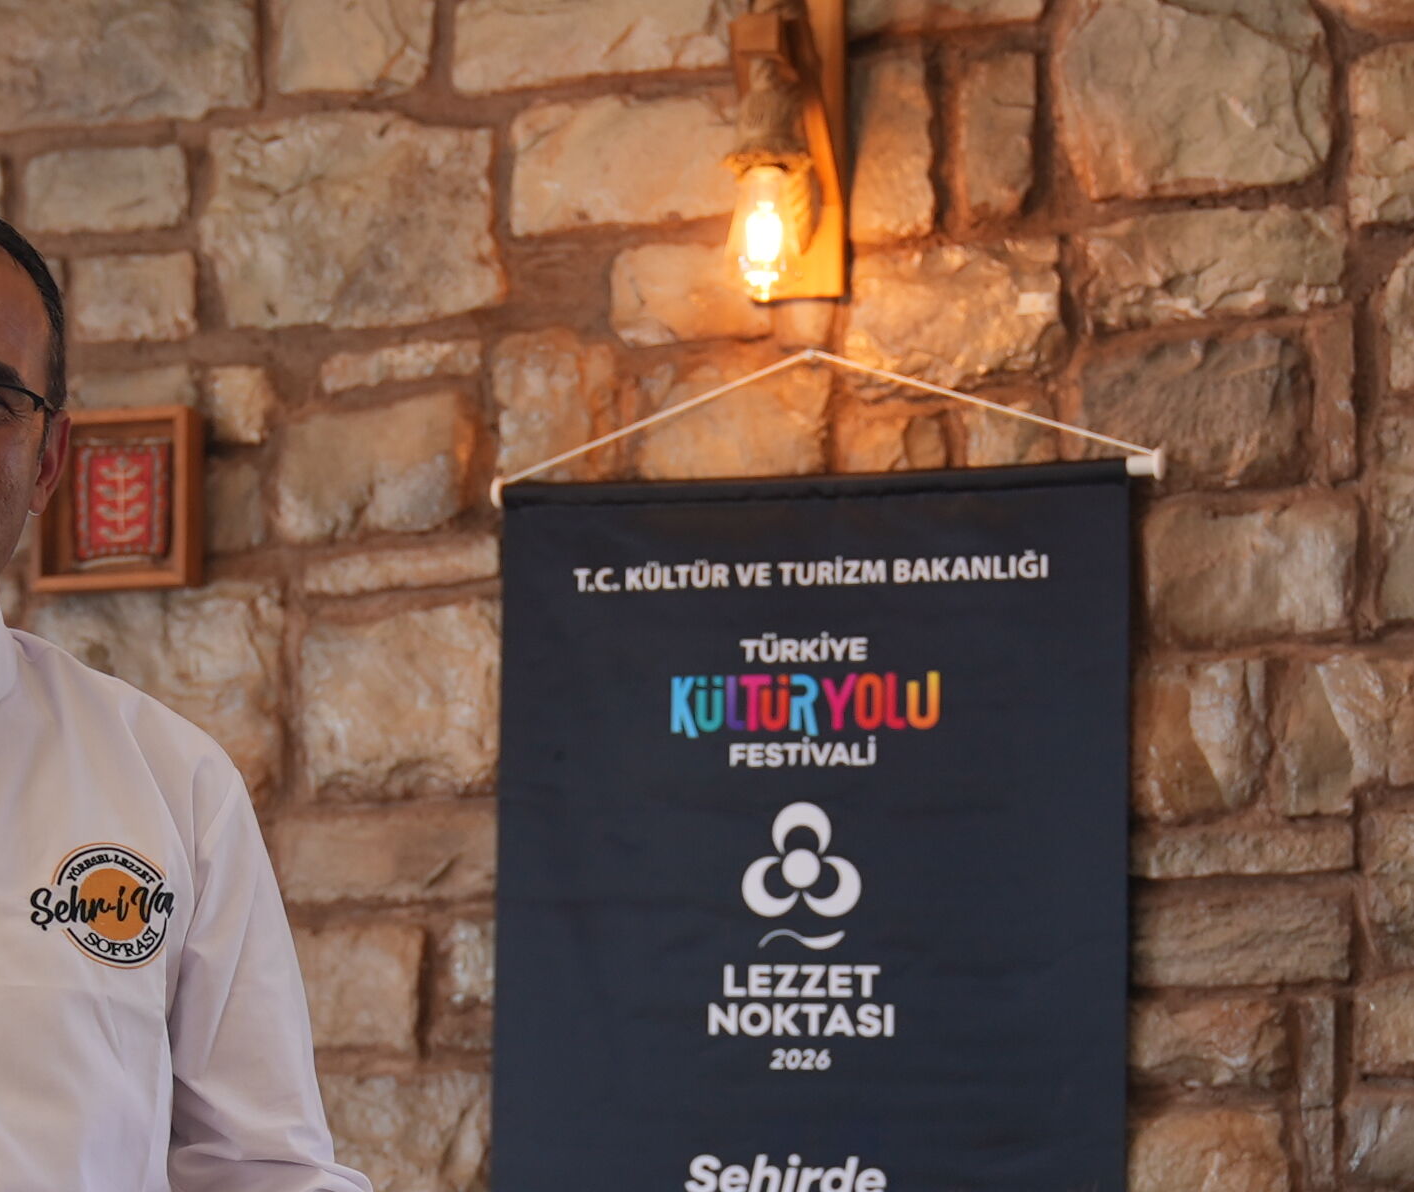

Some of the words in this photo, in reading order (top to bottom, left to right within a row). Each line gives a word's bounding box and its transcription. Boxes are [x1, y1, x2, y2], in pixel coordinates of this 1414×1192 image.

[573, 567, 621, 593] T.C.
[624, 559, 730, 591] KÜLTÜR
[734, 562, 772, 588] VE
[777, 555, 887, 587] TURİZM
[892, 549, 1049, 584] BAKANLIĞI
[739, 631, 869, 664] TÜRKİYE
[729, 734, 877, 768] FESTİVALİ
[114, 854, 155, 885] LEZZET
[84, 927, 160, 957] SOFRASI
[723, 964, 881, 998] LEZZET
[707, 1002, 895, 1038] NOKTASI
[769, 1048, 832, 1071] 2026
